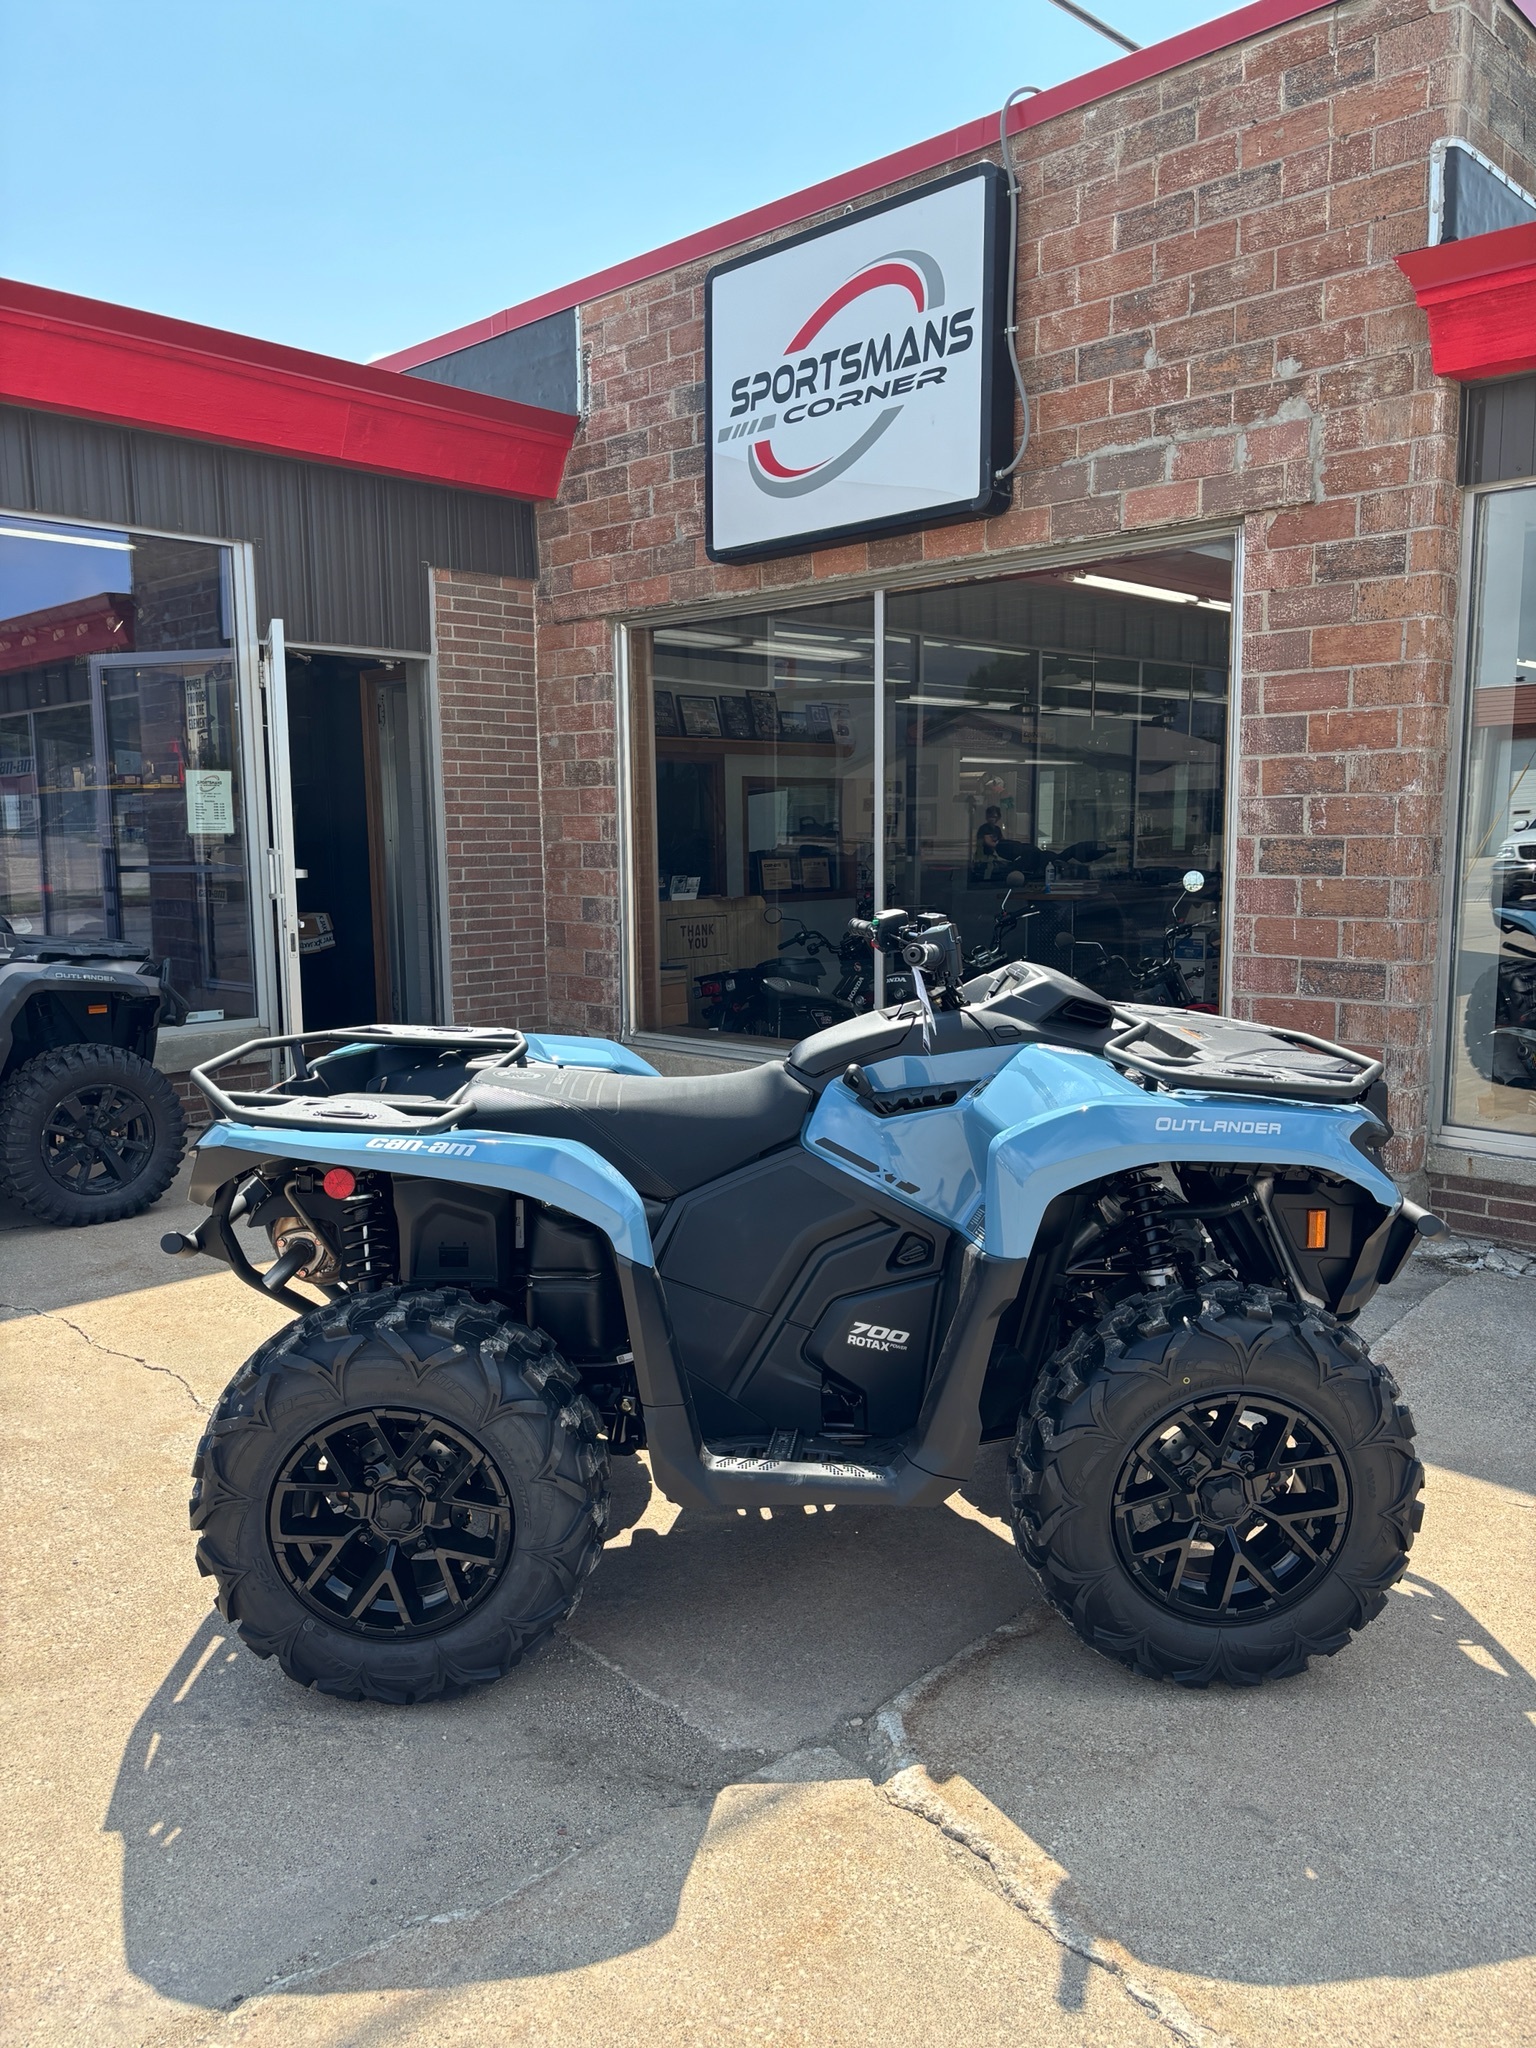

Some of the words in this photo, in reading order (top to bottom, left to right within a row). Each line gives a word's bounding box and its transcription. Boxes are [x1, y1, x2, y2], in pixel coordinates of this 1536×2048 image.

[729, 307, 975, 418] SPORTSMANS
[783, 366, 948, 424] CORNER
[196, 704, 205, 716] THE
[680, 923, 715, 938] THANK
[688, 937, 708, 950] YOU
[847, 976, 865, 1002] HONDA
[886, 976, 907, 984] NDA
[1155, 1116, 1282, 1135] OUTLANDER
[365, 1137, 477, 1157] can-am
[850, 1321, 910, 1344] 700
[847, 1334, 889, 1352] ROTAX
